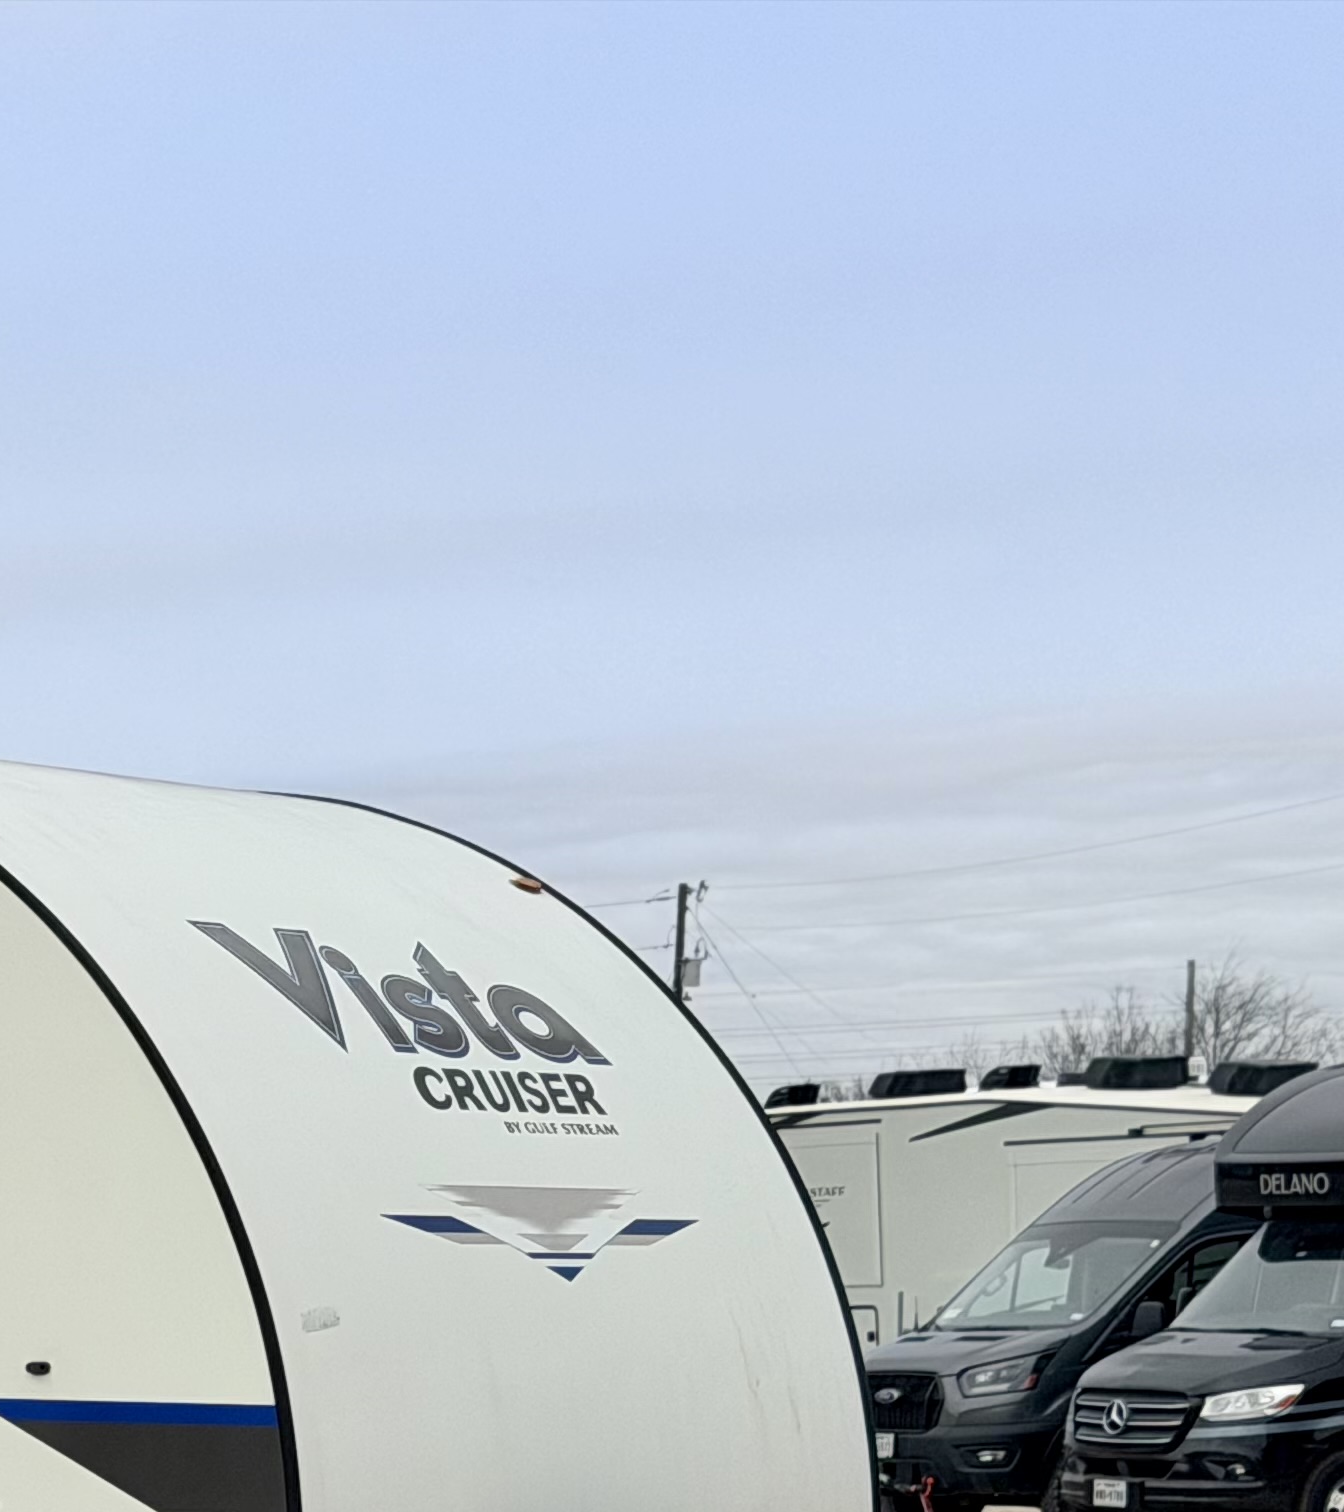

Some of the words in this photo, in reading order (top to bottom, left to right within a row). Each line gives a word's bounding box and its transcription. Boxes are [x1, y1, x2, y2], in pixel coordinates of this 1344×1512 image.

[185, 920, 613, 1066] Vista
[413, 1066, 609, 1116] CRUISER
[503, 1120, 522, 1134] BY
[523, 1121, 559, 1135] GULF
[560, 1122, 620, 1136] STREAM
[1259, 1172, 1330, 1195] DELANO
